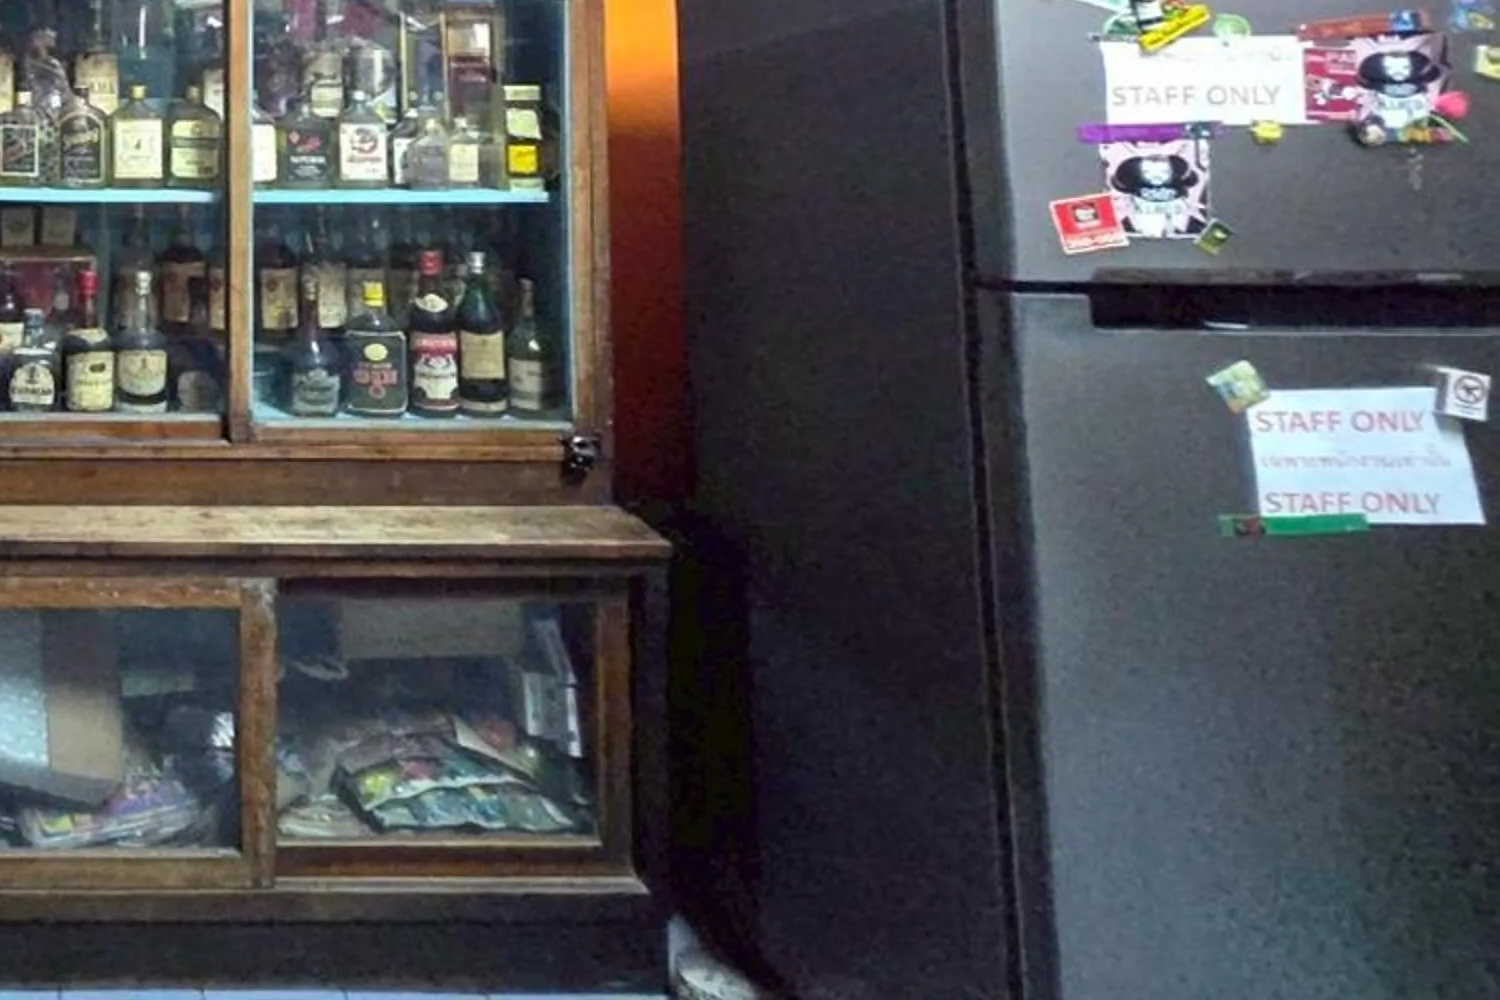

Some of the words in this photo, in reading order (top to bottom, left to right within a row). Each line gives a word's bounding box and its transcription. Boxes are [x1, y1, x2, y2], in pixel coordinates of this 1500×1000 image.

[1111, 86, 1195, 106] STAFF
[1206, 86, 1282, 106] ONLY
[1256, 411, 1342, 432] STAFF
[1351, 410, 1425, 432] ONLY
[1264, 492, 1350, 514] STAFF
[1360, 492, 1440, 514] ONLY
